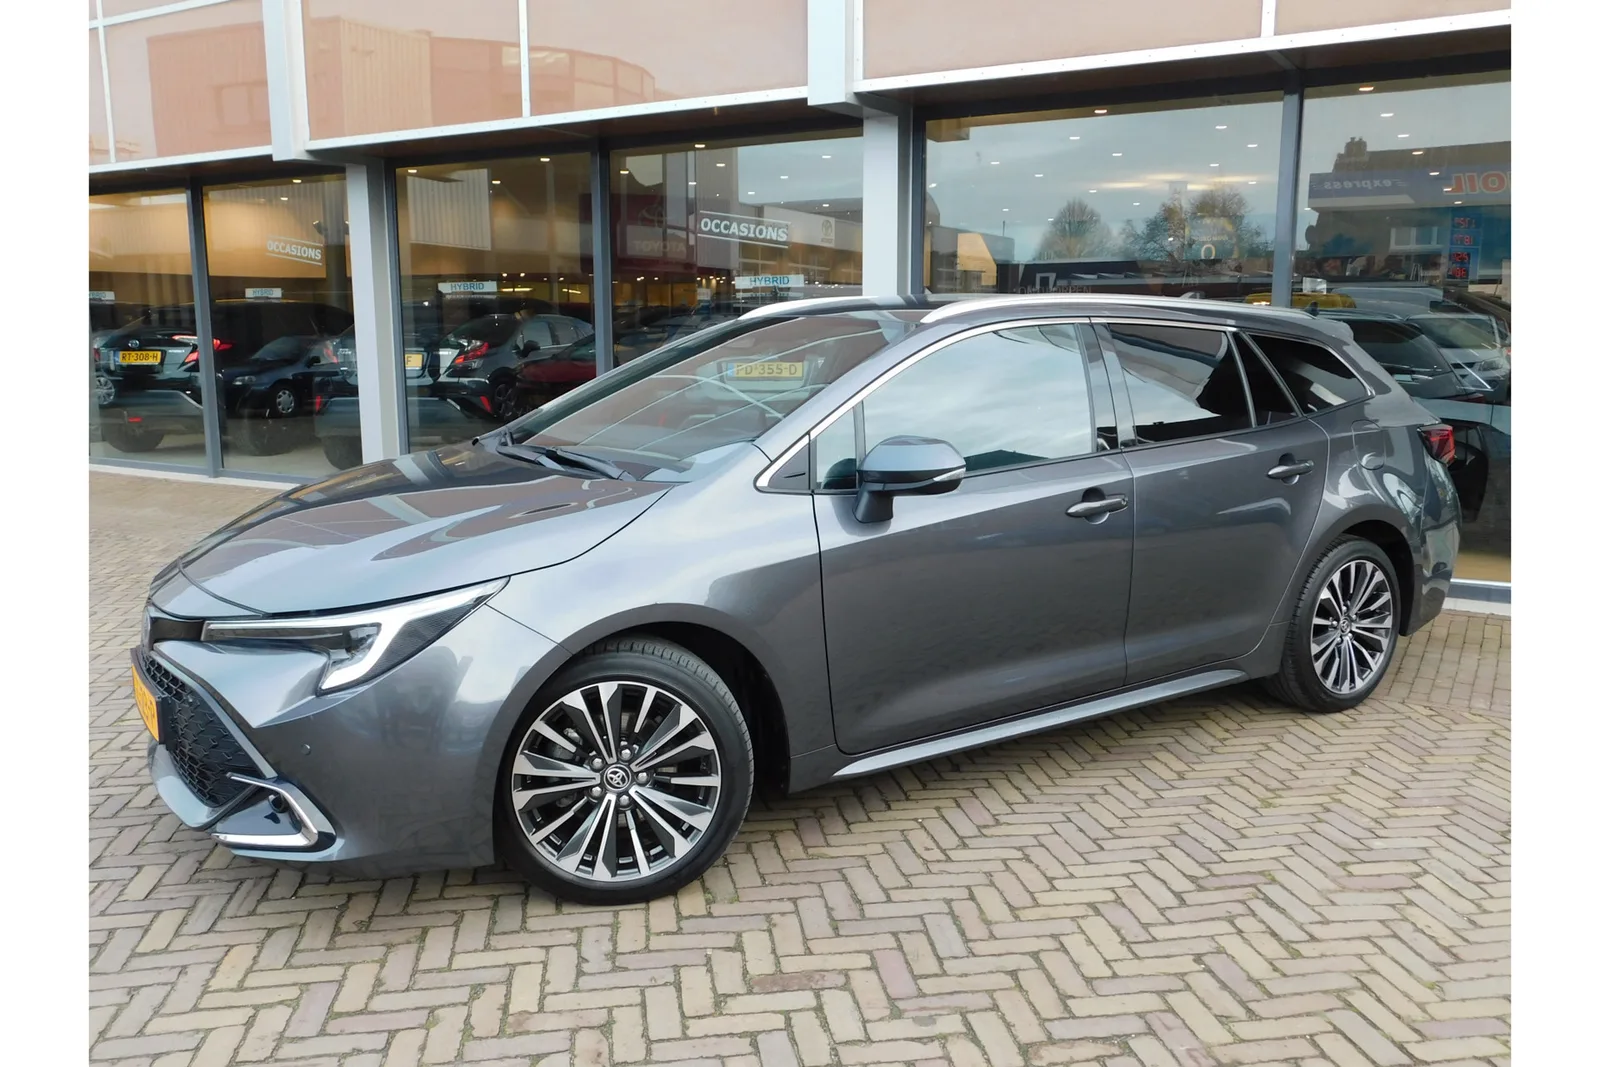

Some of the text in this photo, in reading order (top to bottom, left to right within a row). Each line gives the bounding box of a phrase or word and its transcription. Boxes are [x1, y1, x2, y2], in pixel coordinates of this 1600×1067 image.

[700, 218, 788, 242] OCCASIONS
[267, 240, 322, 260] OCCASIONS
[631, 240, 687, 253] TOYOTA
[749, 275, 790, 286] HYBRID
[252, 288, 274, 296] HYBRID
[450, 282, 485, 291] HYBRID
[121, 352, 159, 362] RT-308-H
